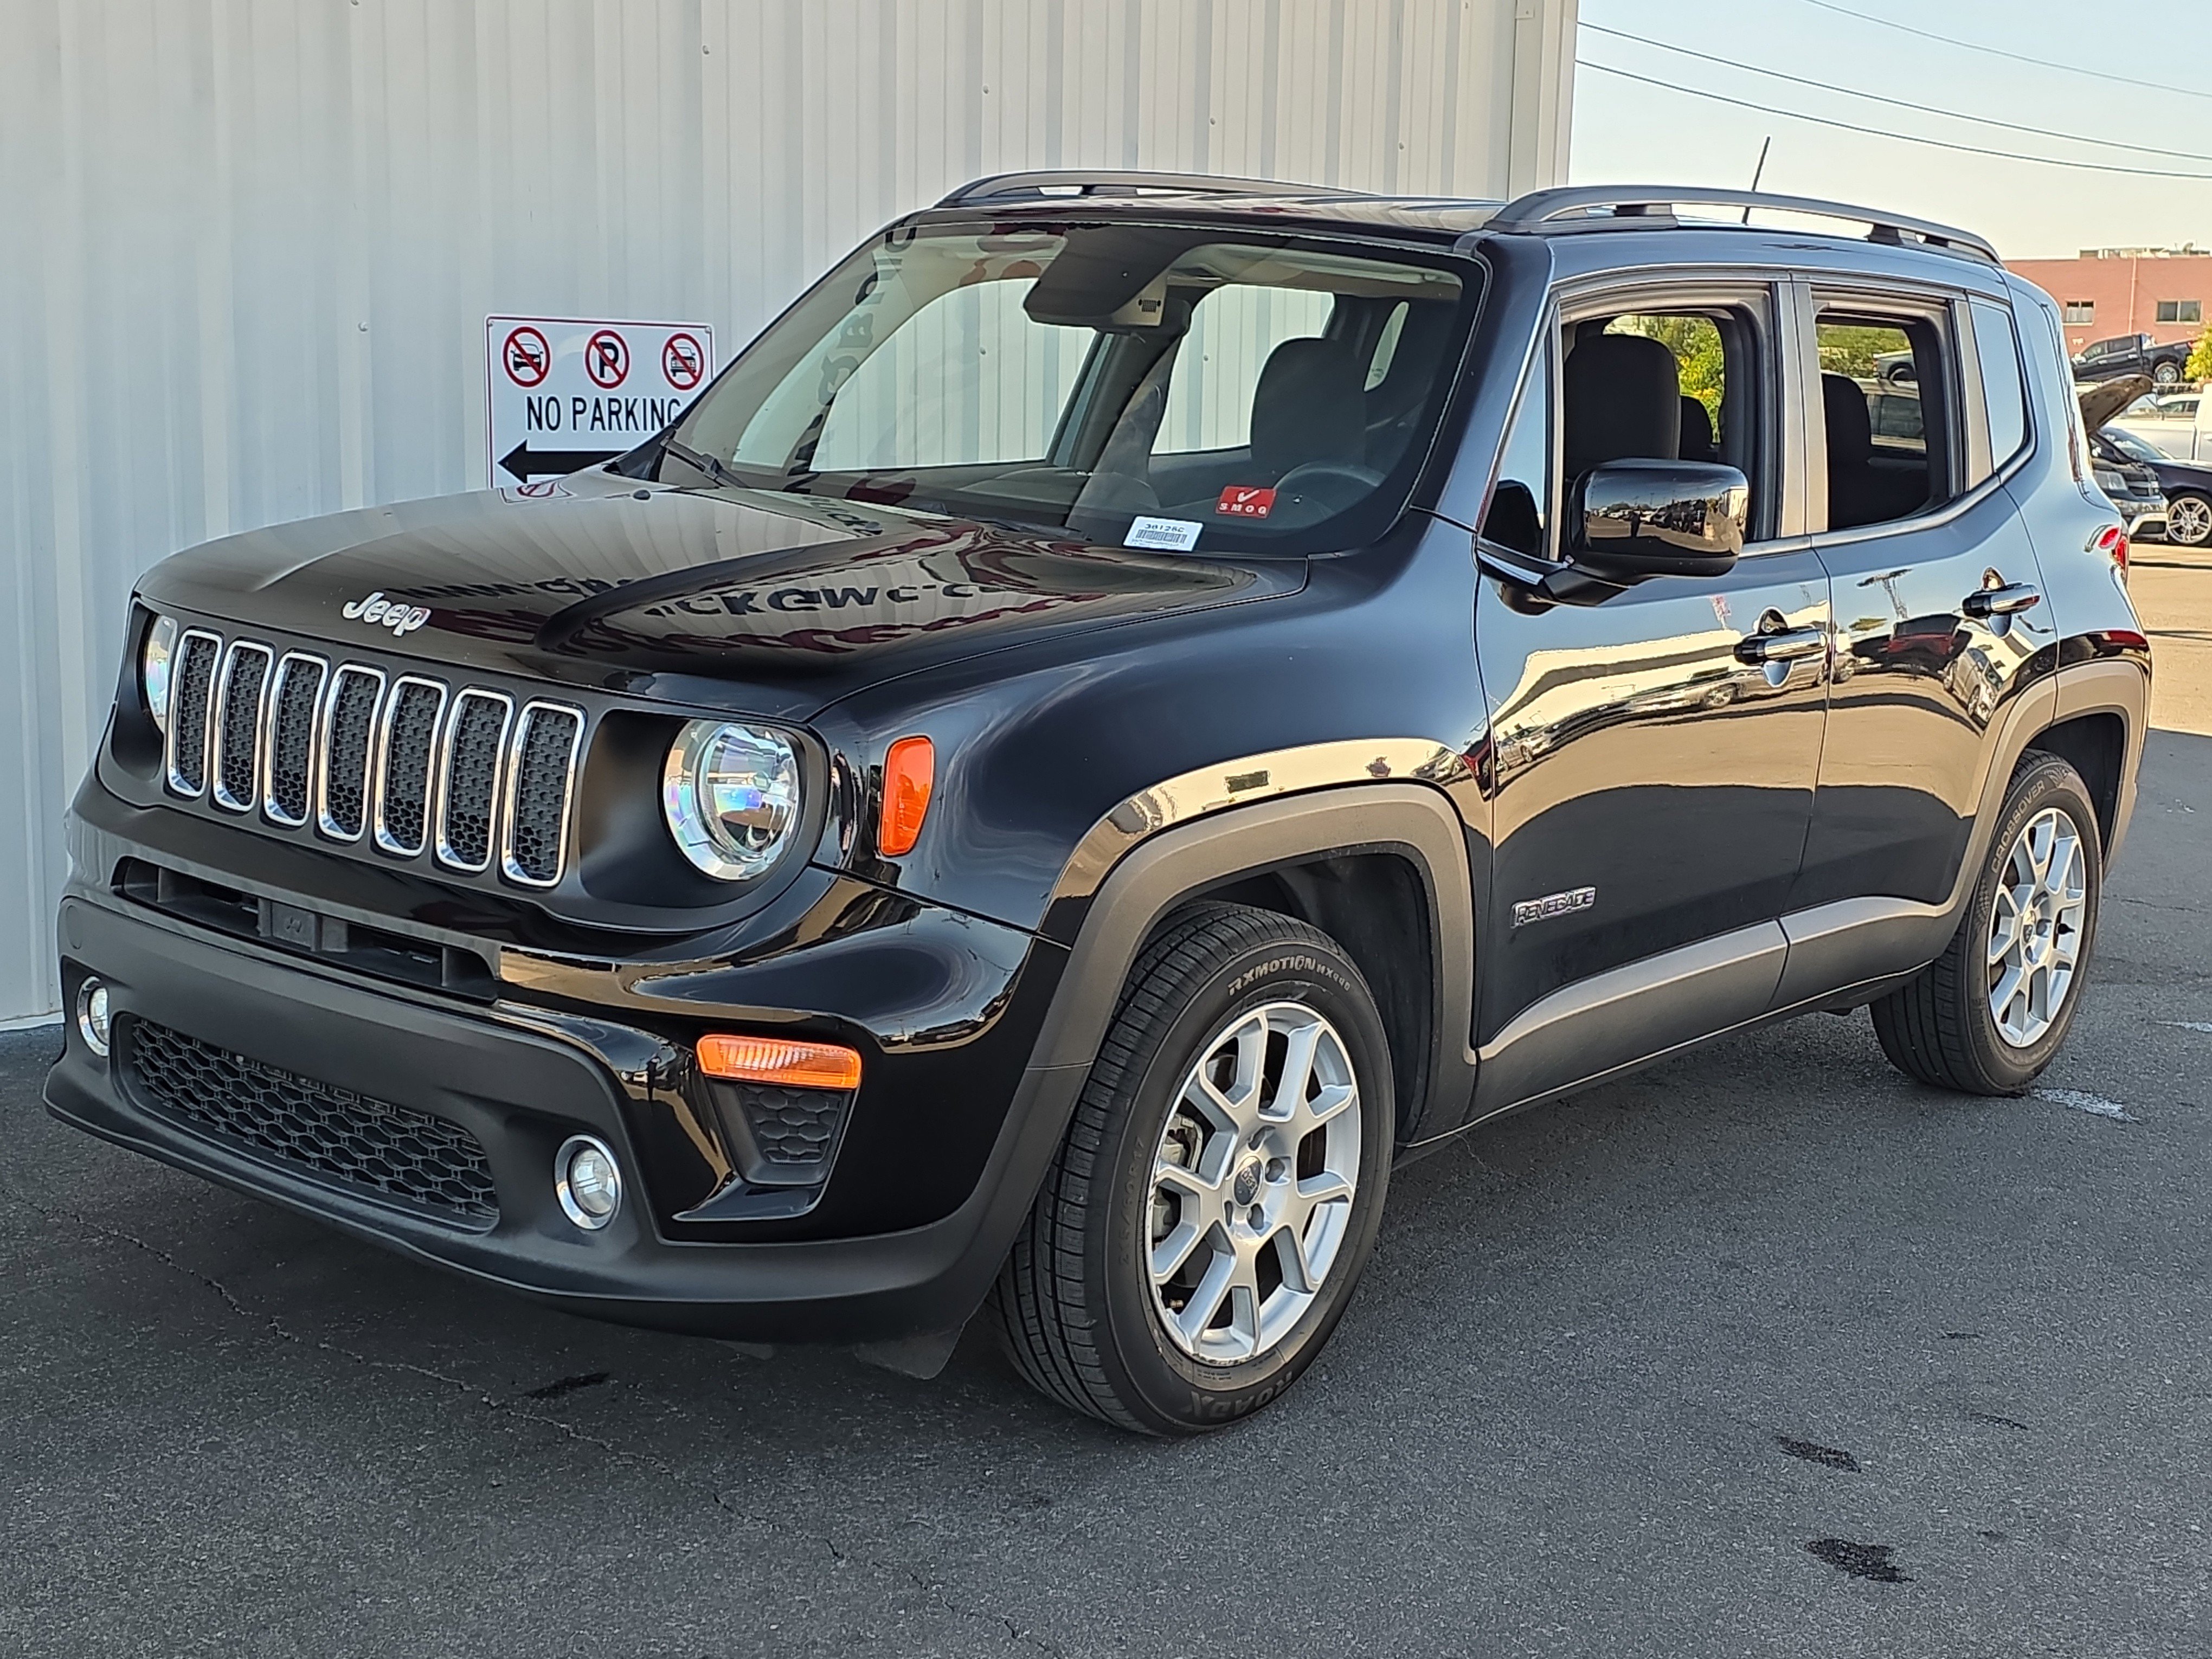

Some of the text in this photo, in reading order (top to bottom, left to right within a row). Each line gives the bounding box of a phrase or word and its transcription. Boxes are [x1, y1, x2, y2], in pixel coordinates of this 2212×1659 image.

[527, 396, 561, 431] NO
[1218, 502, 1267, 515] SMOG
[343, 591, 432, 637] Jeep
[1510, 886, 1596, 929] RENEGADE
[1227, 955, 1316, 996] RXMOTION
